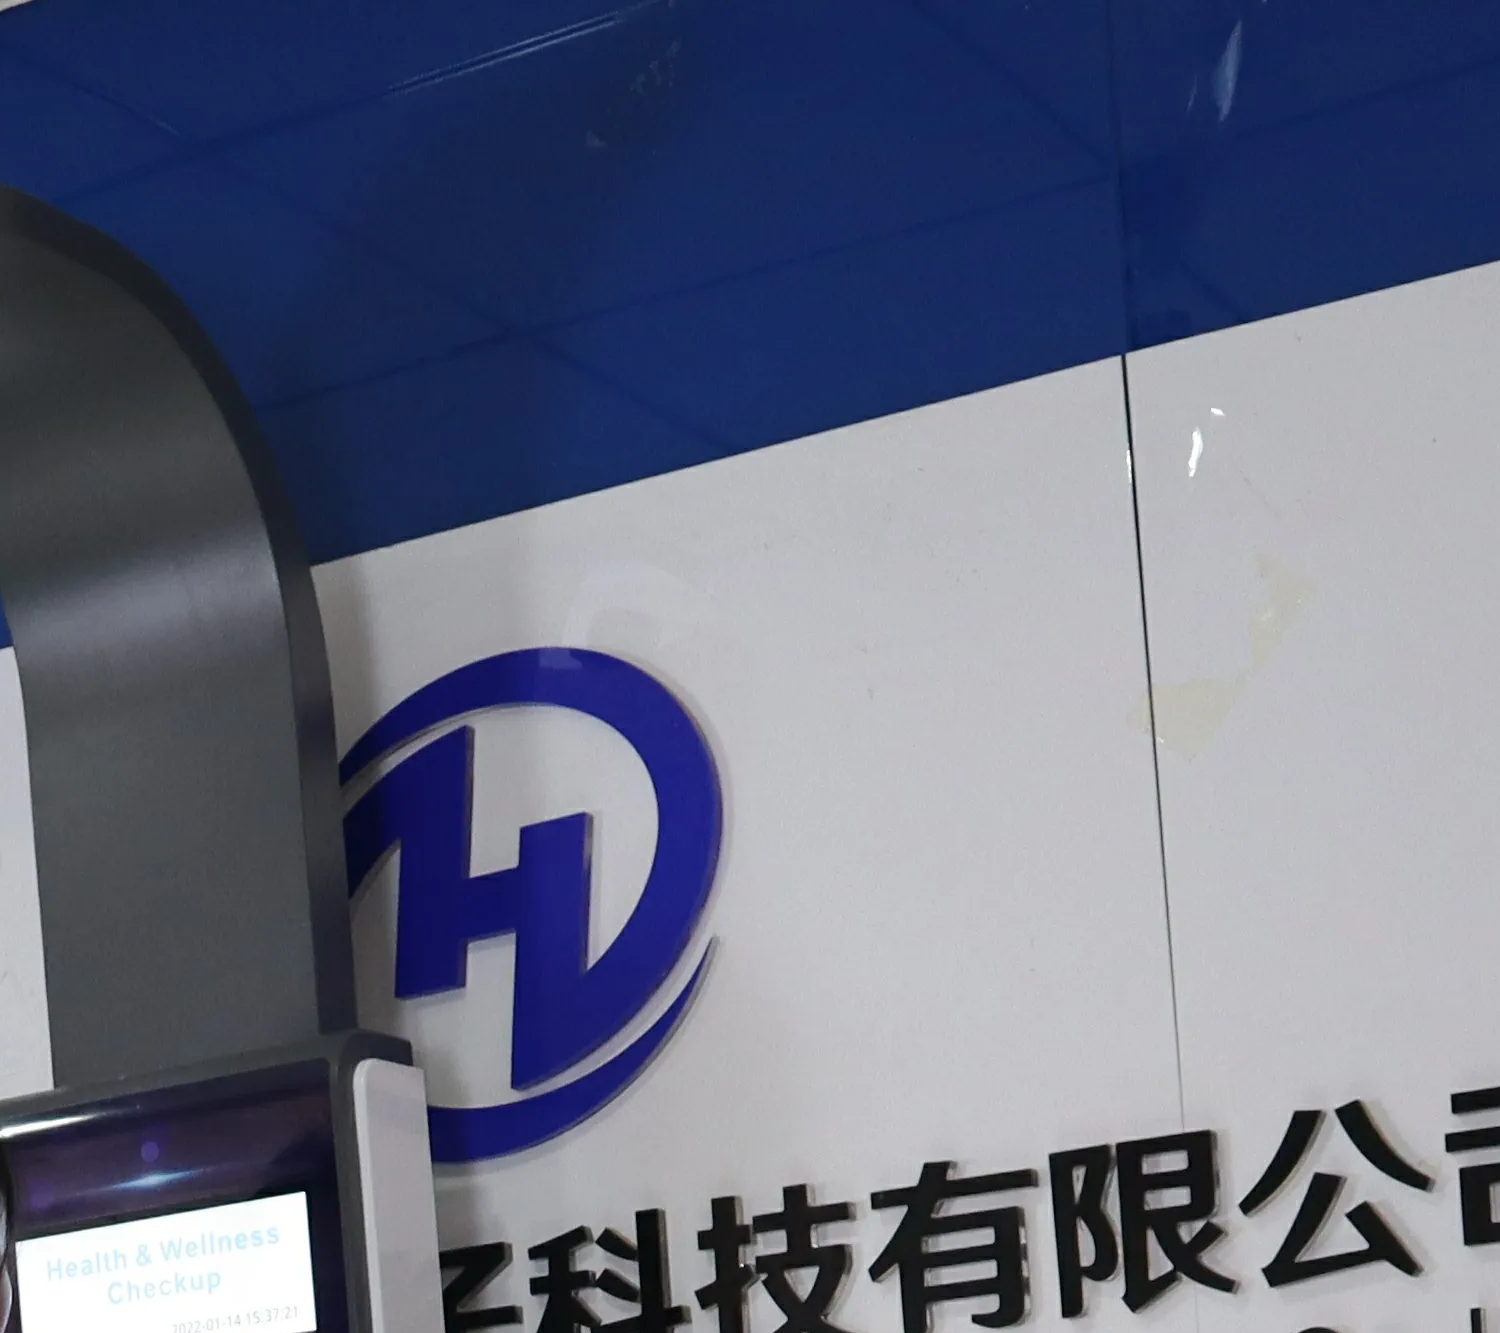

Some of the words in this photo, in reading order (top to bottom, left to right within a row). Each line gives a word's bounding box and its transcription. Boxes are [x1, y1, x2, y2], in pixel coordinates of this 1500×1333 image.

[46, 1245, 128, 1283] Health
[135, 1243, 153, 1268] &
[159, 1225, 281, 1264] Wellness
[106, 1271, 222, 1306] Checkup
